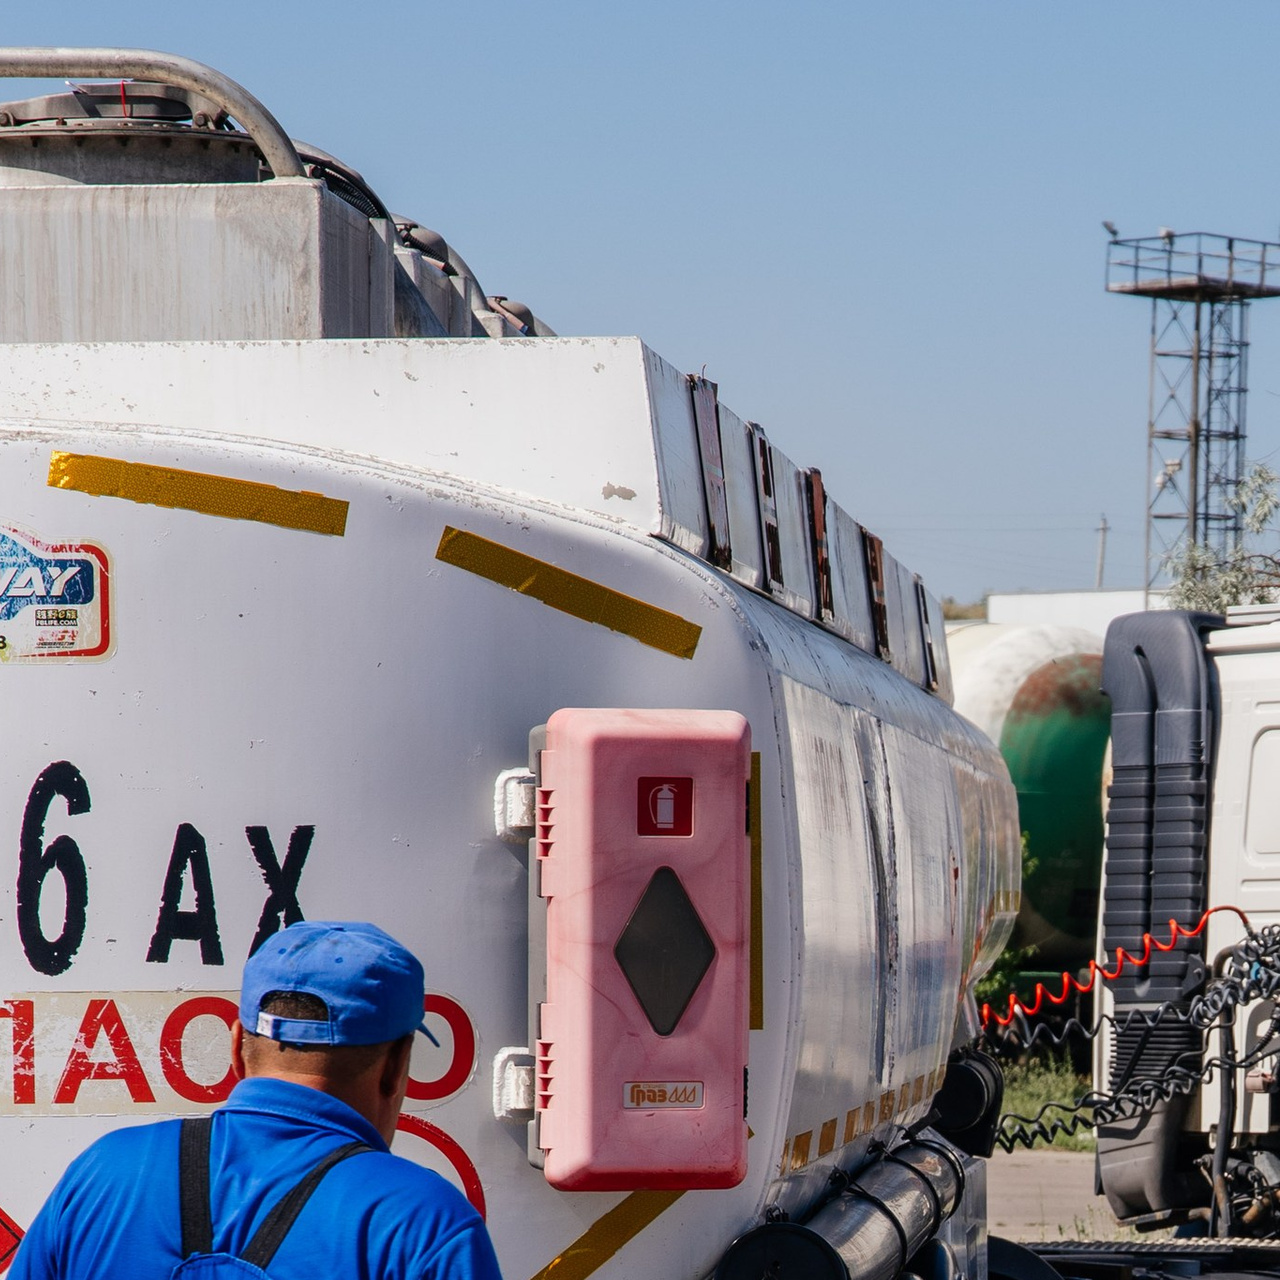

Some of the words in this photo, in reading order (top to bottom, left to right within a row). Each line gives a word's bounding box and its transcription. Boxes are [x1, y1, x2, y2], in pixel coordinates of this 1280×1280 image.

[17, 760, 91, 976] 6
[146, 822, 316, 965] AX
[0, 997, 475, 1104] АСО
